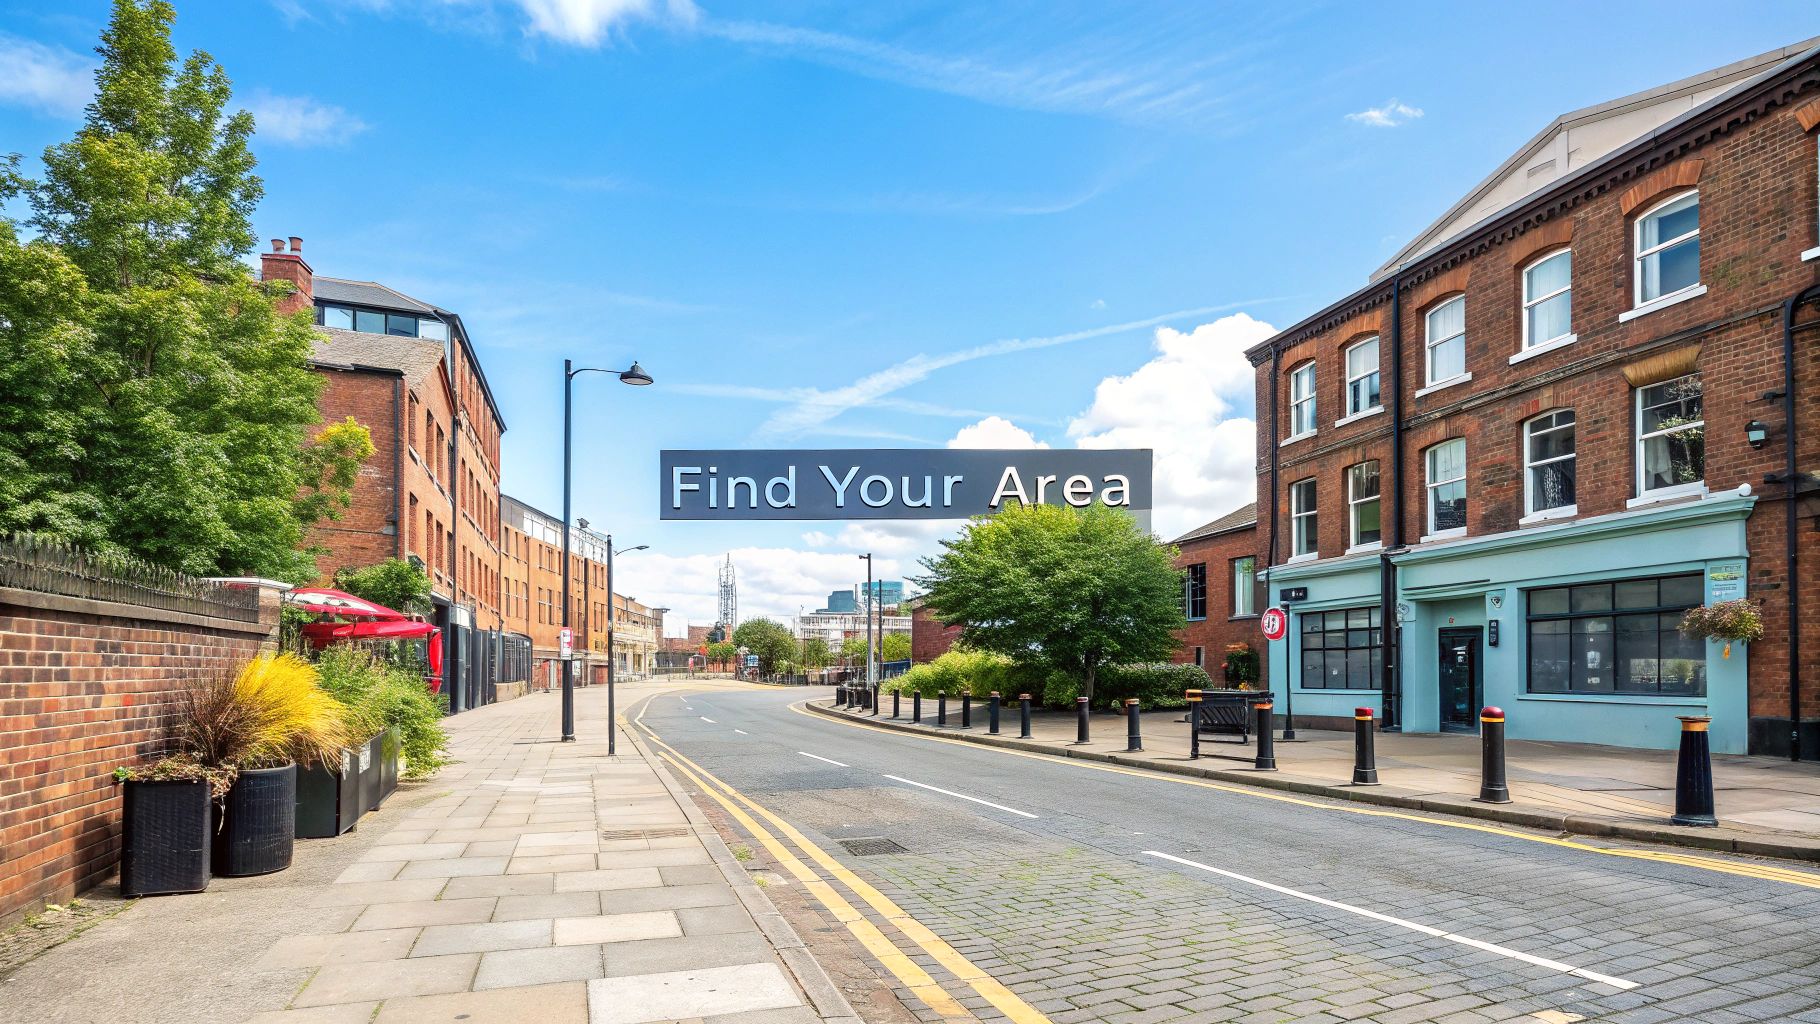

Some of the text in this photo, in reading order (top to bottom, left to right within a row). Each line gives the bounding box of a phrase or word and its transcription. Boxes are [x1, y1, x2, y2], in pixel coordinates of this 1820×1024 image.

[671, 465, 1131, 509] Find Your Area
